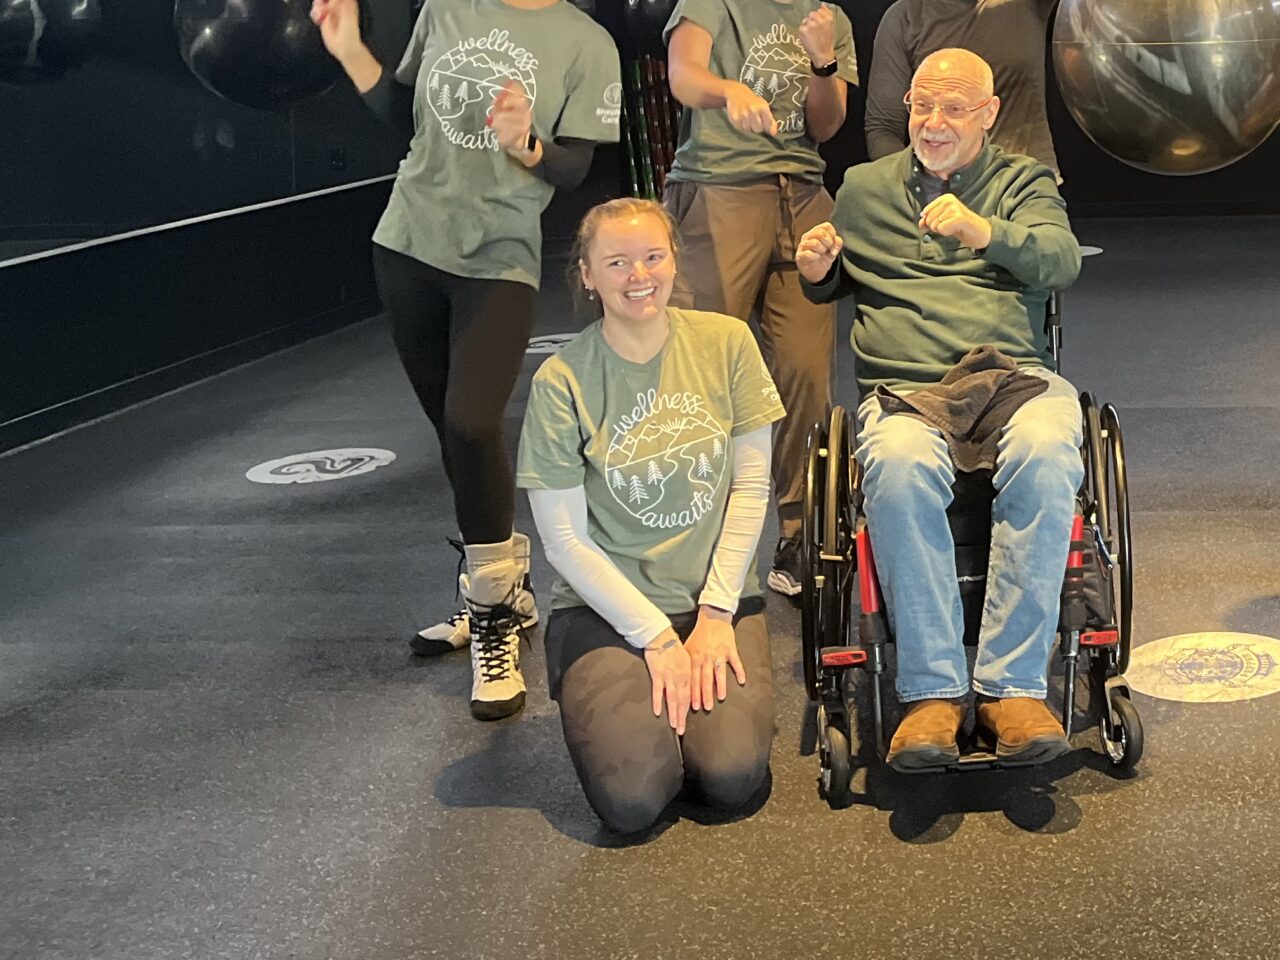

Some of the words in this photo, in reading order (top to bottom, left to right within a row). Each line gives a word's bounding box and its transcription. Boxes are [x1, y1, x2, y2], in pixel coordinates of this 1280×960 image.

[458, 27, 539, 71] wellness
[441, 120, 499, 152] awaits
[613, 388, 704, 436] wellness
[641, 490, 713, 528] awaits
